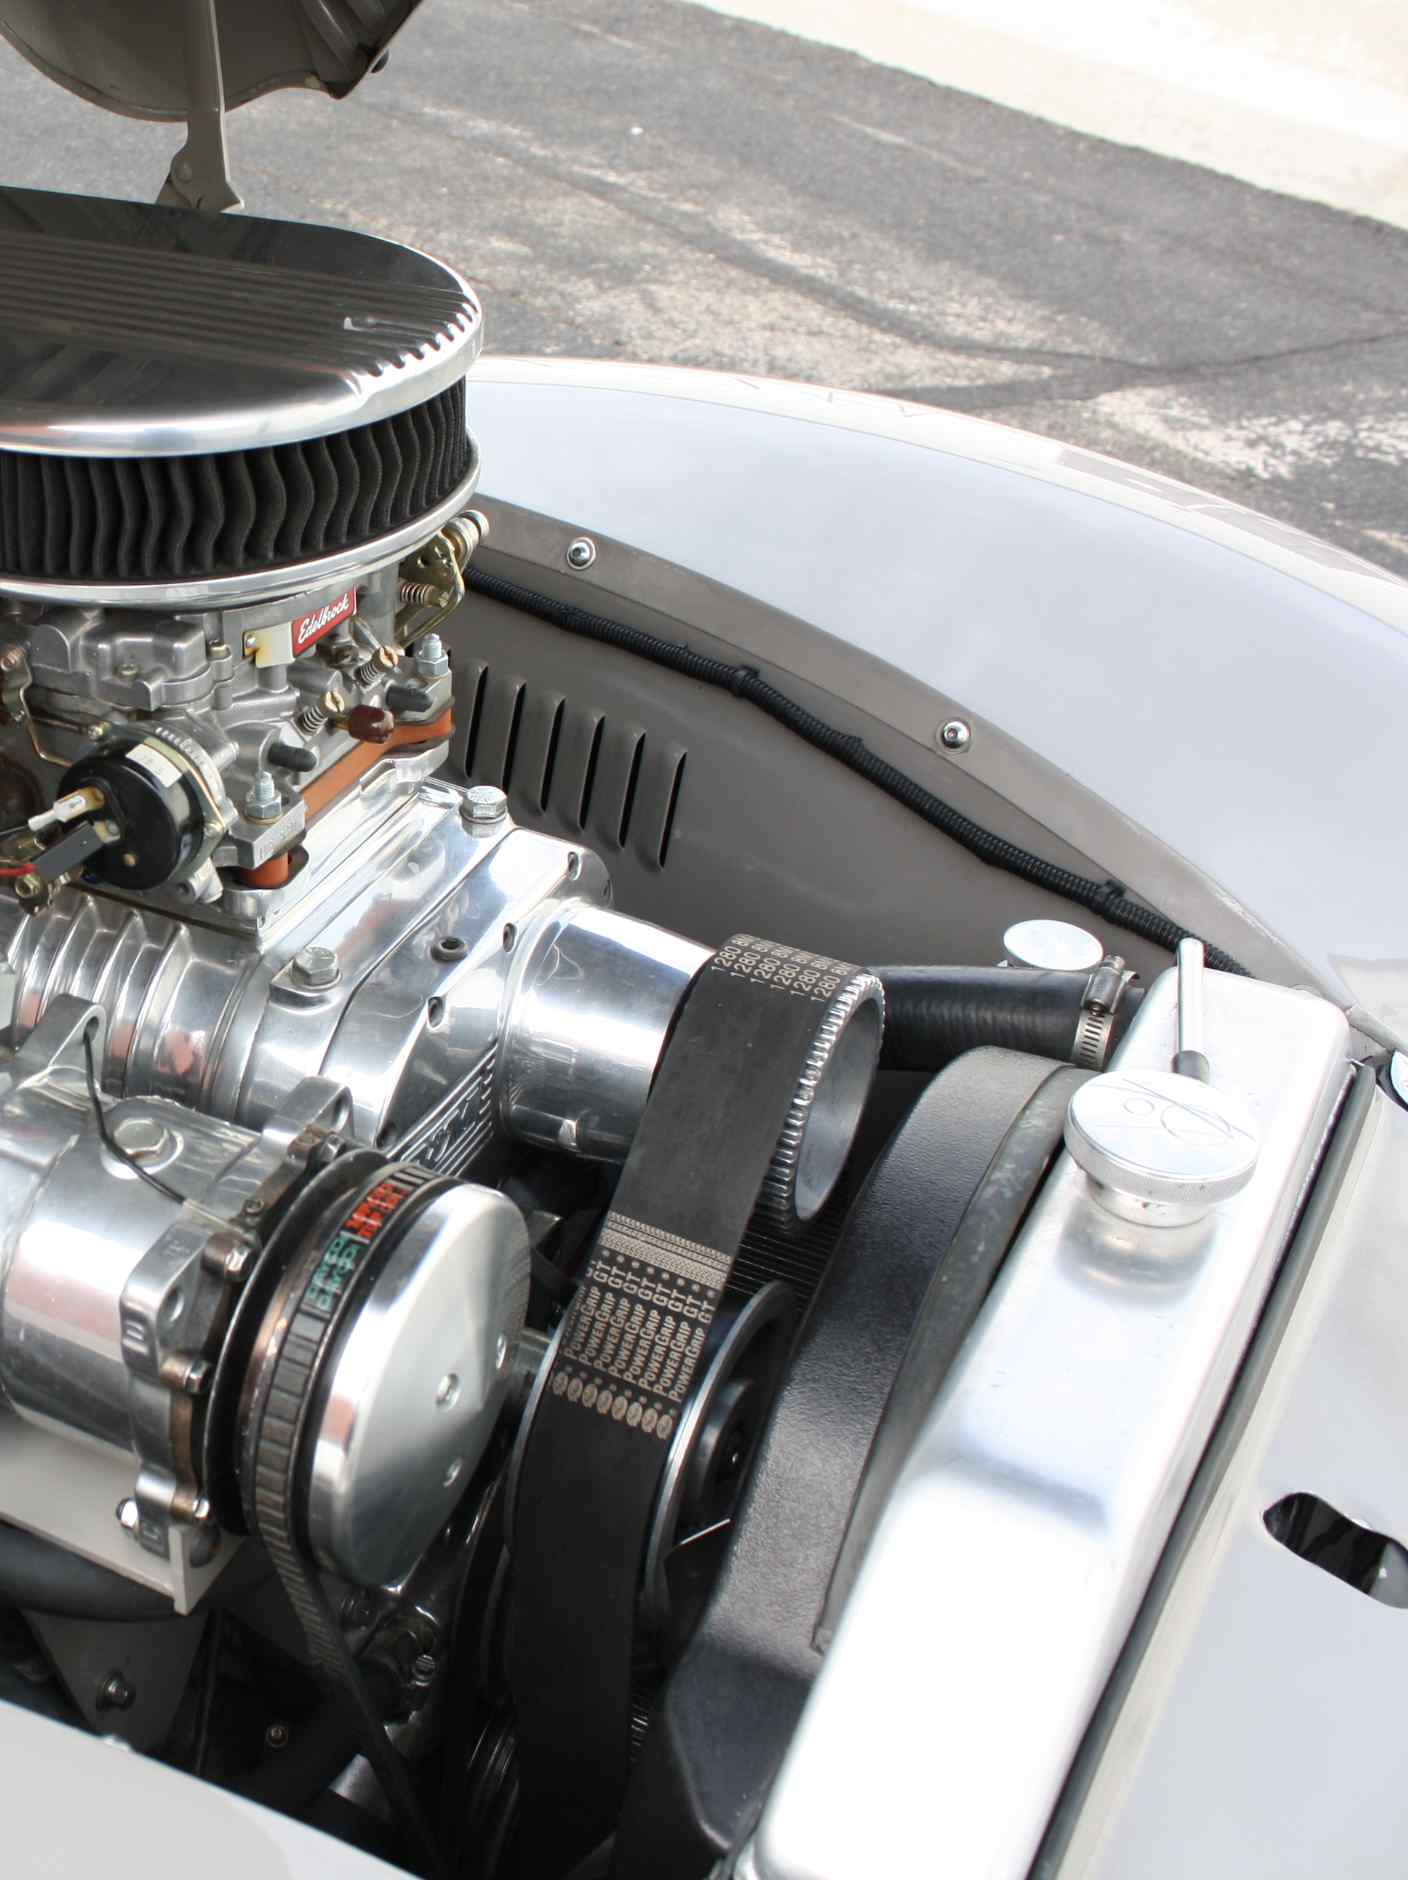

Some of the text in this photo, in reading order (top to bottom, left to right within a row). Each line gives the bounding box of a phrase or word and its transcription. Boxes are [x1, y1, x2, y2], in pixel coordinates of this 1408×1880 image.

[297, 592, 350, 645] Edelbrock
[711, 945, 742, 972] 1280
[730, 951, 761, 978] 1280
[750, 957, 781, 985] 1280
[770, 963, 801, 991] 1280
[790, 969, 821, 997] 1280
[810, 975, 841, 1003] 1280
[593, 1260, 611, 1283] GT
[607, 1266, 626, 1289] GT
[622, 1271, 641, 1295] GT
[638, 1278, 656, 1301] GT
[652, 1283, 671, 1307] GT
[667, 1289, 686, 1313] GT
[683, 1295, 701, 1319] GT
[698, 1301, 716, 1325] GT
